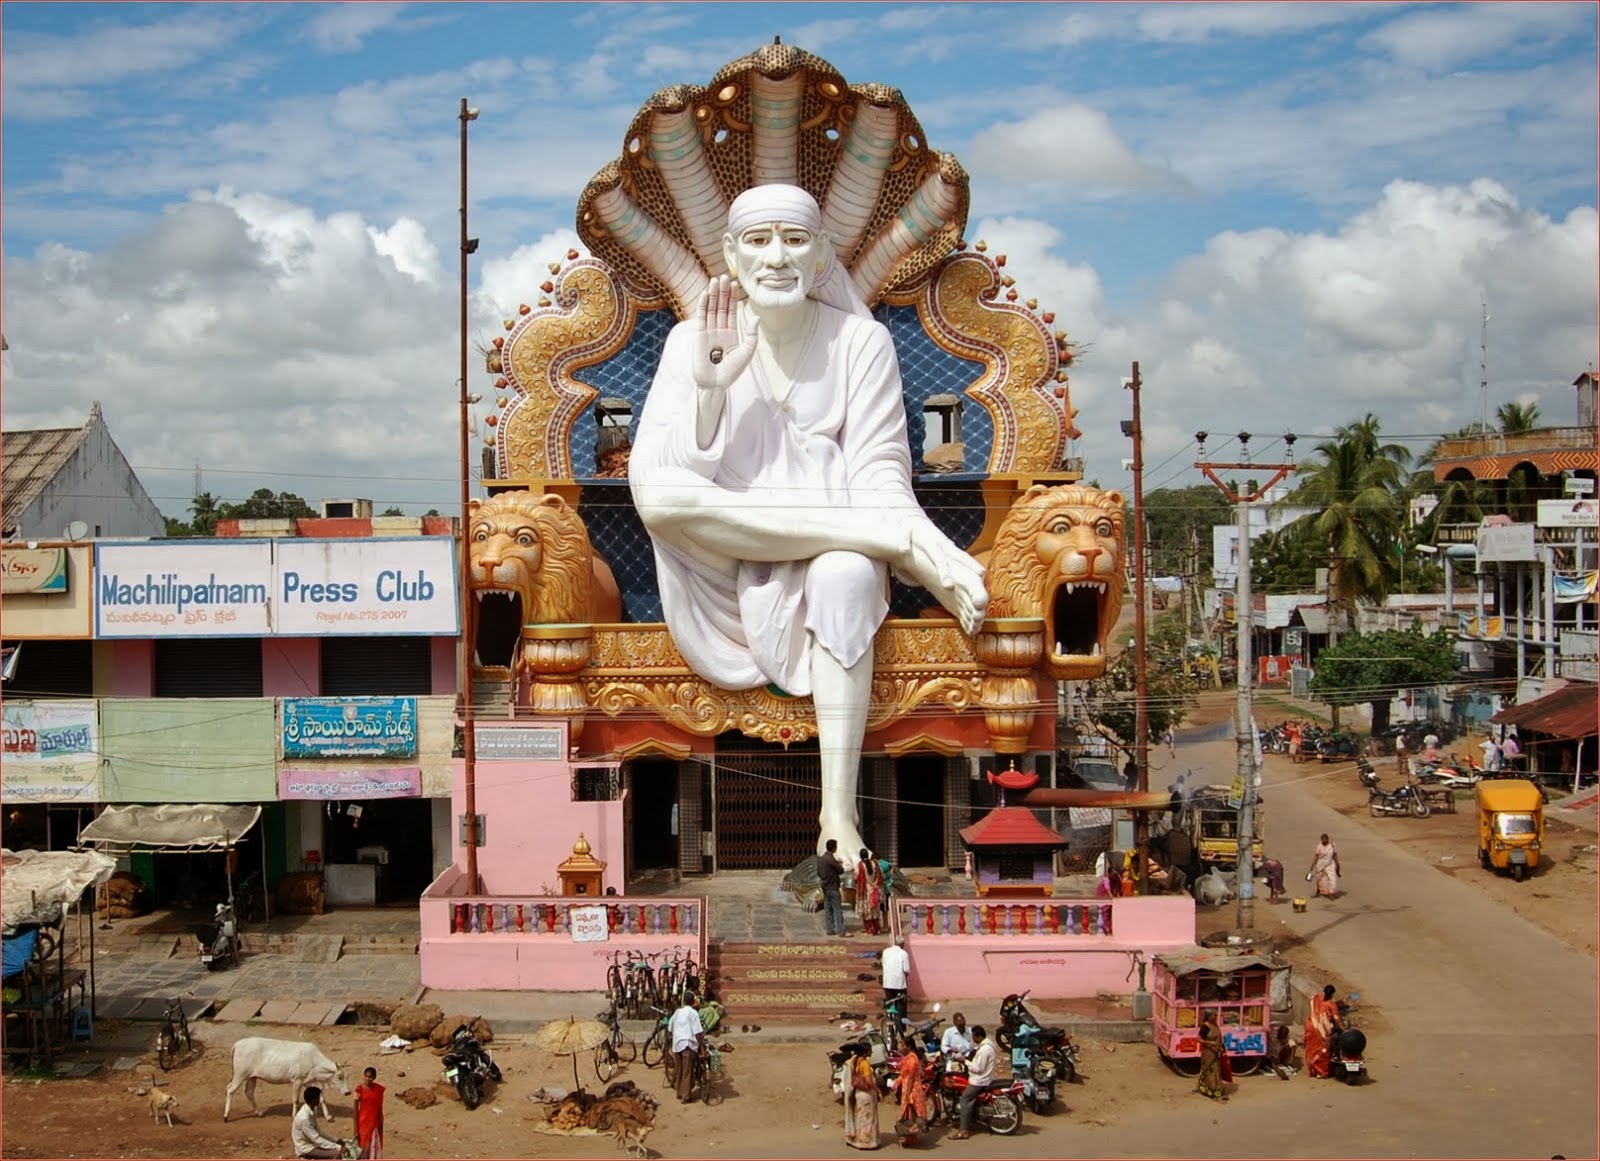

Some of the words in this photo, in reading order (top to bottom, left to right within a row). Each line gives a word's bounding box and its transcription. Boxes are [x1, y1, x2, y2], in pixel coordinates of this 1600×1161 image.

[102, 573, 266, 614] Machilipatnam
[284, 571, 358, 603] Press
[376, 570, 434, 602] Club
